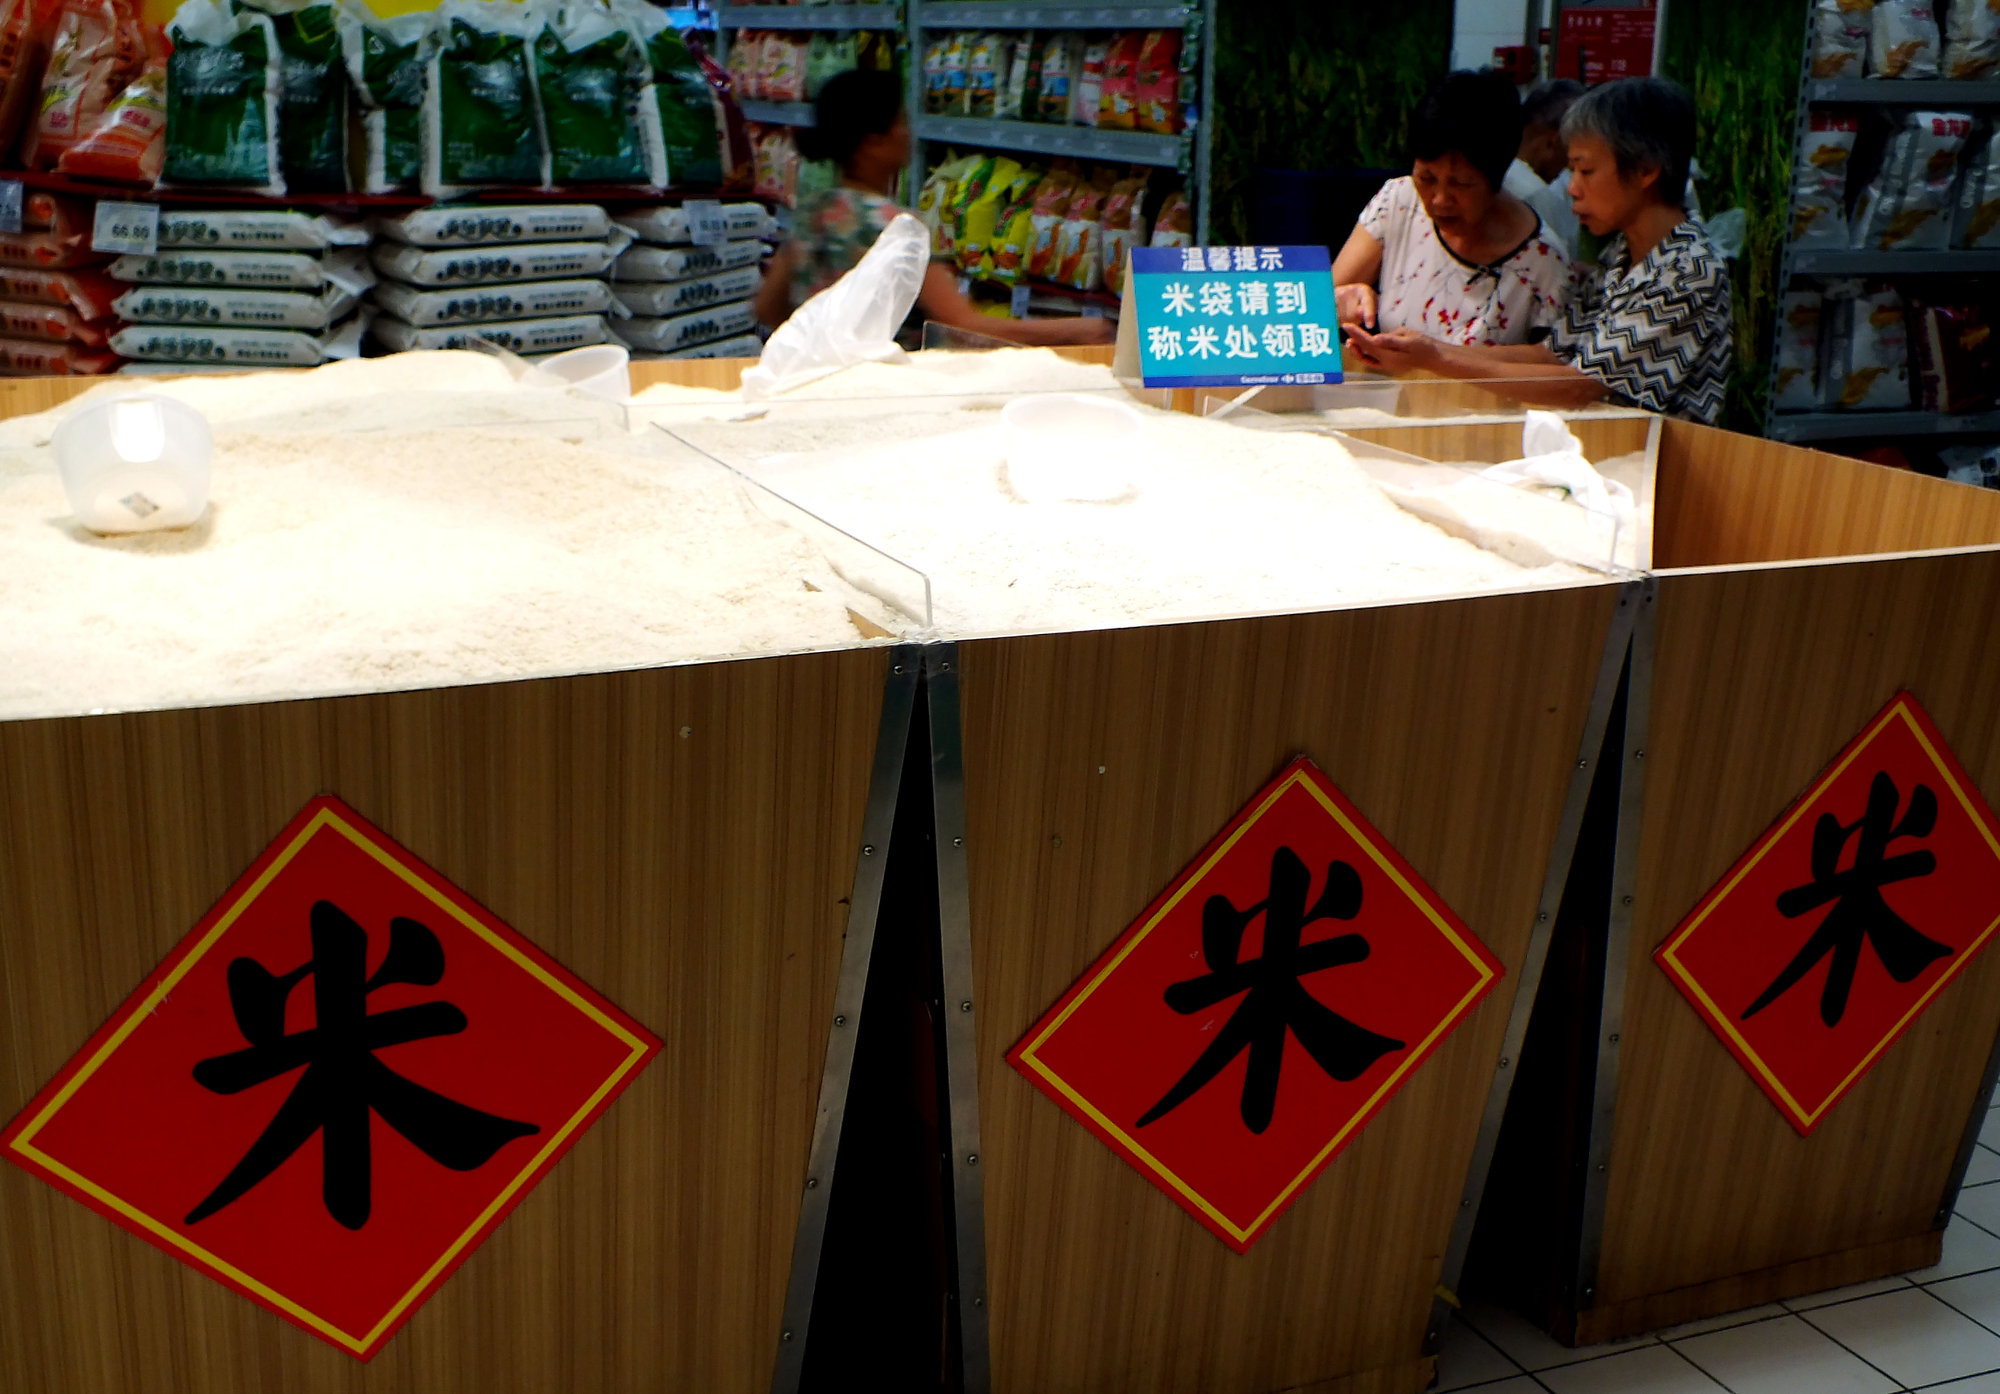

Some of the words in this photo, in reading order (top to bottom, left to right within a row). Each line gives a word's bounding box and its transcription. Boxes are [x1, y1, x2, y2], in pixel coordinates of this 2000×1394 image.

[1161, 281, 1307, 317] 米袋请到
[1181, 247, 1284, 272] 温馨提示
[1147, 323, 1333, 361] 称米处领取
[1740, 771, 1954, 1027] 米
[1136, 846, 1405, 1134] 米
[184, 900, 540, 1230] 米
